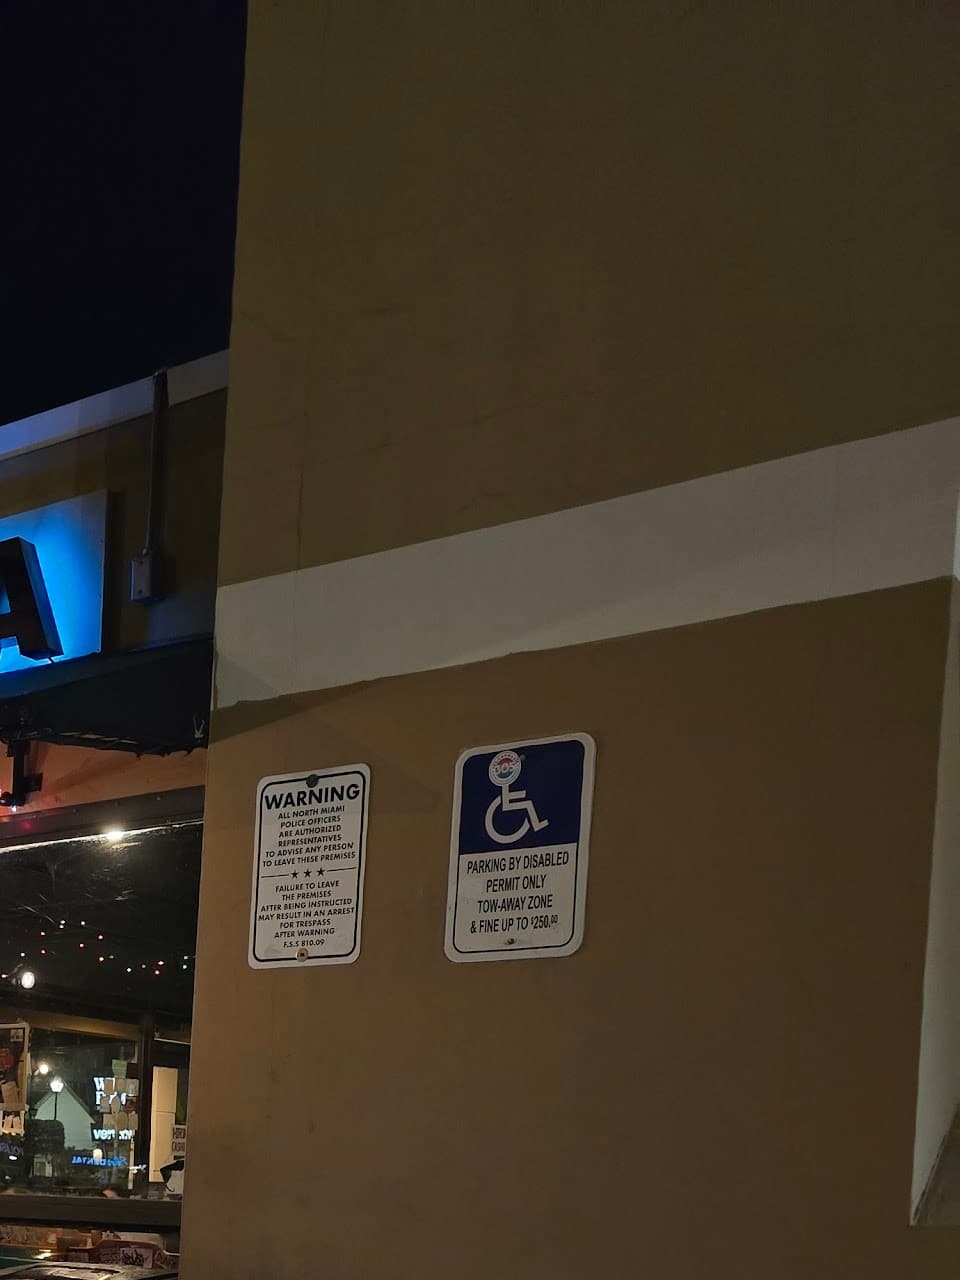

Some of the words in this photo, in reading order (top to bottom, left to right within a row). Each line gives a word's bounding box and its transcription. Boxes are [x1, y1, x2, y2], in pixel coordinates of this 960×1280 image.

[264, 784, 360, 810] WARNING
[278, 812, 290, 820] ALL
[293, 809, 319, 818] NORTH
[321, 805, 344, 815] MIAMI
[280, 819, 306, 829] POLICE
[307, 815, 341, 826] OFFICERS
[279, 830, 293, 838] ARE
[295, 825, 342, 837] AUTHORIZED
[278, 834, 342, 847] REPRESENTATIVES
[277, 848, 303, 856] ADVISE
[305, 846, 322, 854] ANY
[324, 842, 354, 852] PERSON
[274, 857, 295, 866] LEAVE
[297, 855, 318, 864] THESE
[321, 852, 356, 862] PREMISES
[466, 858, 506, 874] PARKING
[509, 856, 521, 871] BY
[524, 851, 570, 869] DISABLED
[275, 884, 303, 893] FAILURE
[318, 880, 339, 889] LEAVE
[486, 876, 520, 893] PERMIT
[522, 874, 547, 890] ONLY
[297, 890, 331, 899] PREMISES
[260, 904, 282, 912] AFTER
[283, 902, 306, 910] BEING
[308, 898, 352, 908] INSTRUCTED
[477, 896, 527, 914] TOW-AWAY
[528, 894, 553, 909] ZONE
[277, 912, 301, 920] RESULT
[327, 907, 354, 916] ARREST
[279, 921, 294, 929] FOR
[296, 918, 331, 927] TRESPASS
[470, 920, 477, 934] &
[479, 919, 499, 933] FINE
[501, 918, 514, 932] UP
[517, 916, 529, 930] TO
[274, 930, 295, 939] AFTER
[298, 927, 335, 937] WARNING
